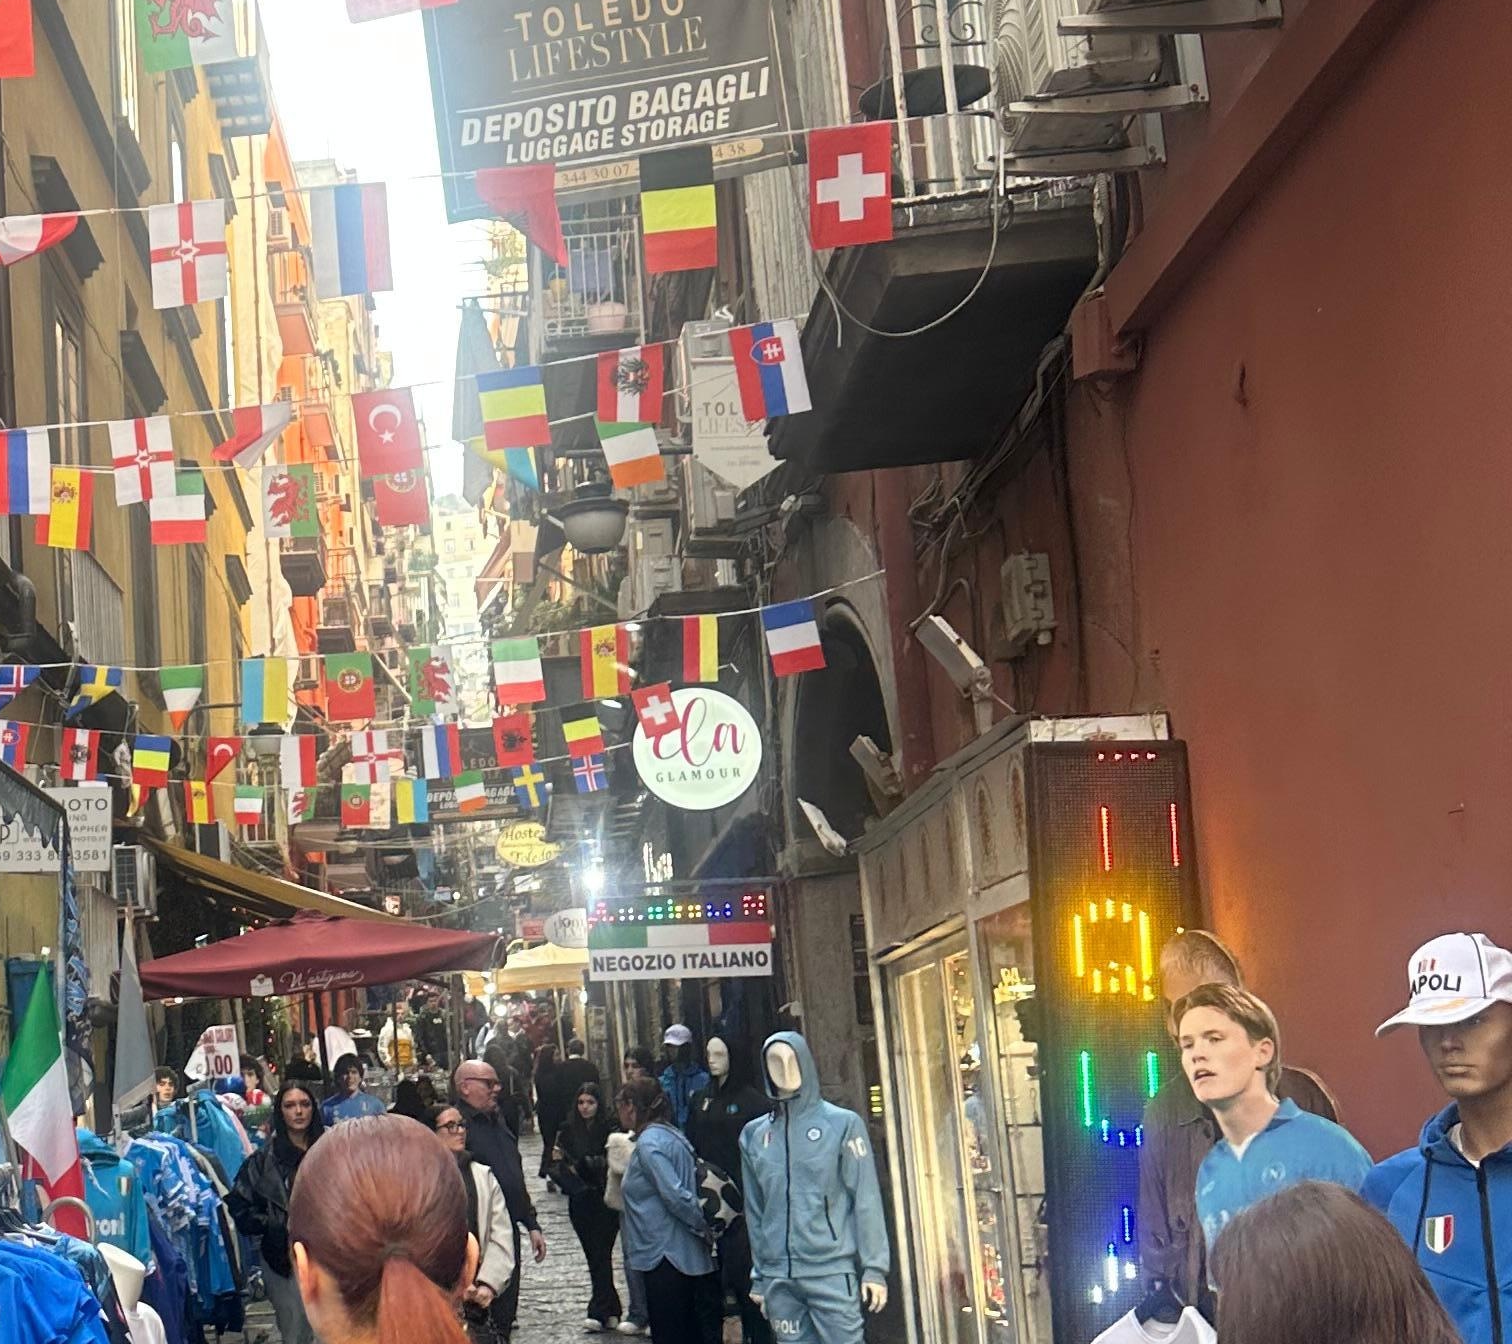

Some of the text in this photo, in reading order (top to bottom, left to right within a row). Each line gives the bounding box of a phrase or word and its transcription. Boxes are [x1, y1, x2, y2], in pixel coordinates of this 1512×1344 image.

[508, 16, 707, 83] LIFESTYLE
[461, 66, 770, 146] DEPOSITO BAGAGLI
[506, 107, 730, 164] LUGGAGE STORAGE
[656, 768, 741, 783] GLAMOUR
[593, 951, 768, 972] NEGOZIO ITALIANO
